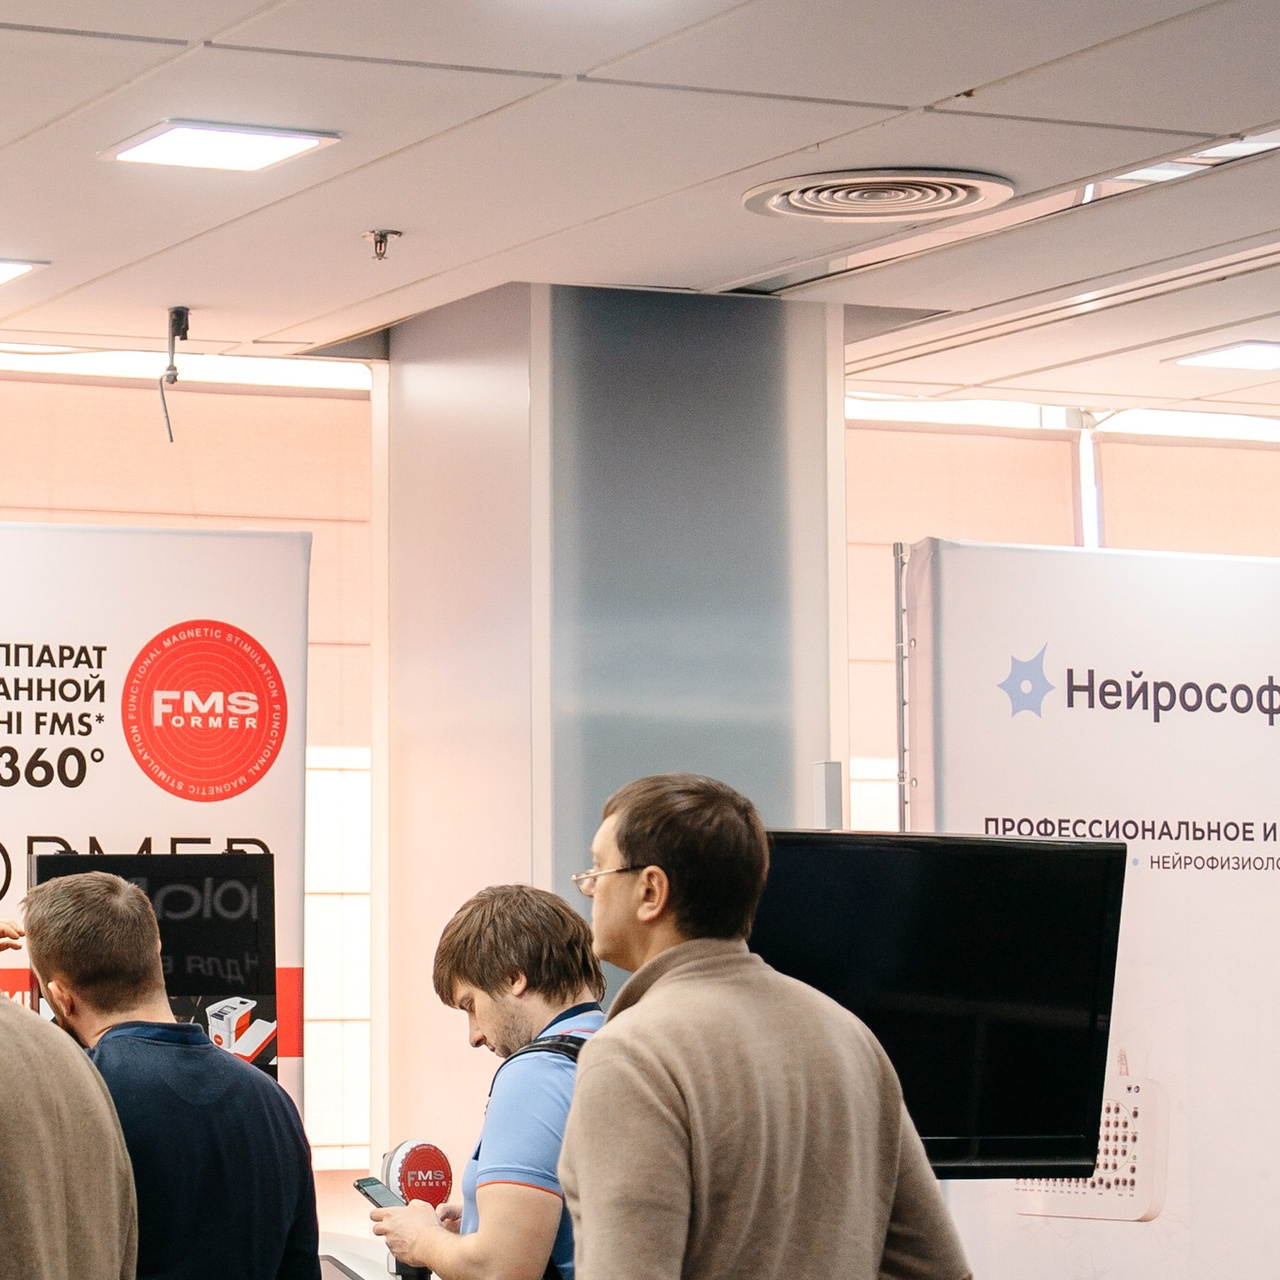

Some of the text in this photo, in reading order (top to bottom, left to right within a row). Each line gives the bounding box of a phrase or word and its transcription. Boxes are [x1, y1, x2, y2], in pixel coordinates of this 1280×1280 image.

[128, 627, 281, 796] FUNCTIONAL MAGNETIC STIMULATION FUNCTIONAL MAGNETIC STIMULATION
[153, 690, 260, 728] FMS
[1066, 668, 1280, 727] Нейрософ
[984, 818, 1255, 842] ПРОФЕССИОНАЛЬНОЕ
[407, 1170, 445, 1187] FMS
